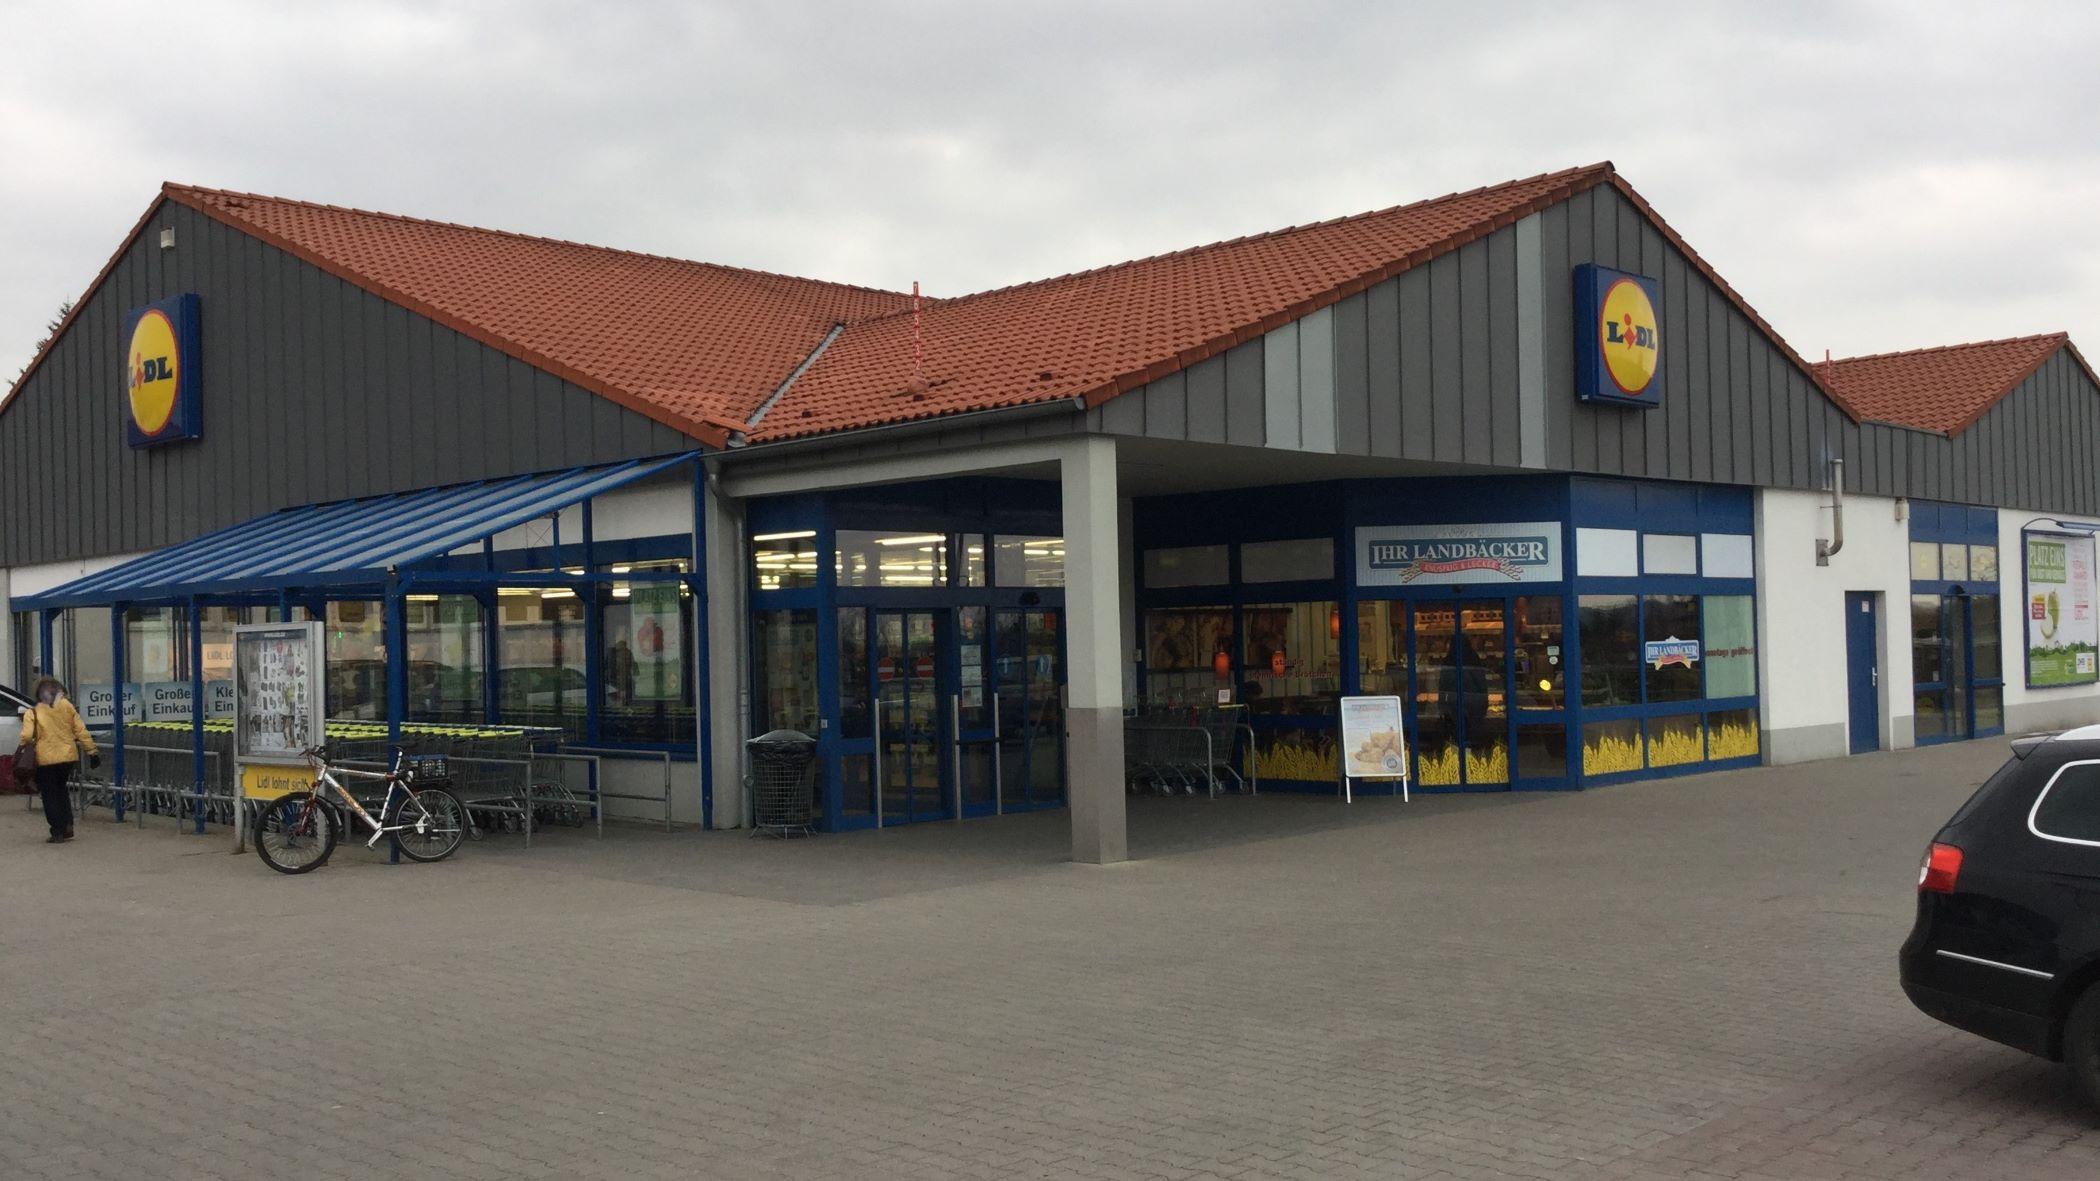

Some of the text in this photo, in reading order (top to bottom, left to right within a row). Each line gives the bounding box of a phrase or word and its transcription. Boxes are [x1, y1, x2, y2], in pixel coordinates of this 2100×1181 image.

[1606, 313, 1655, 351] LIDL
[128, 352, 172, 390] LIDL
[1372, 540, 1545, 564] IHR LANDBÄCKER
[90, 691, 132, 703] Groer
[155, 688, 192, 700] Große
[87, 703, 136, 717] Einkuf
[153, 702, 193, 715] Einkau
[257, 775, 270, 788] Lidl
[272, 776, 290, 790] lohnt
